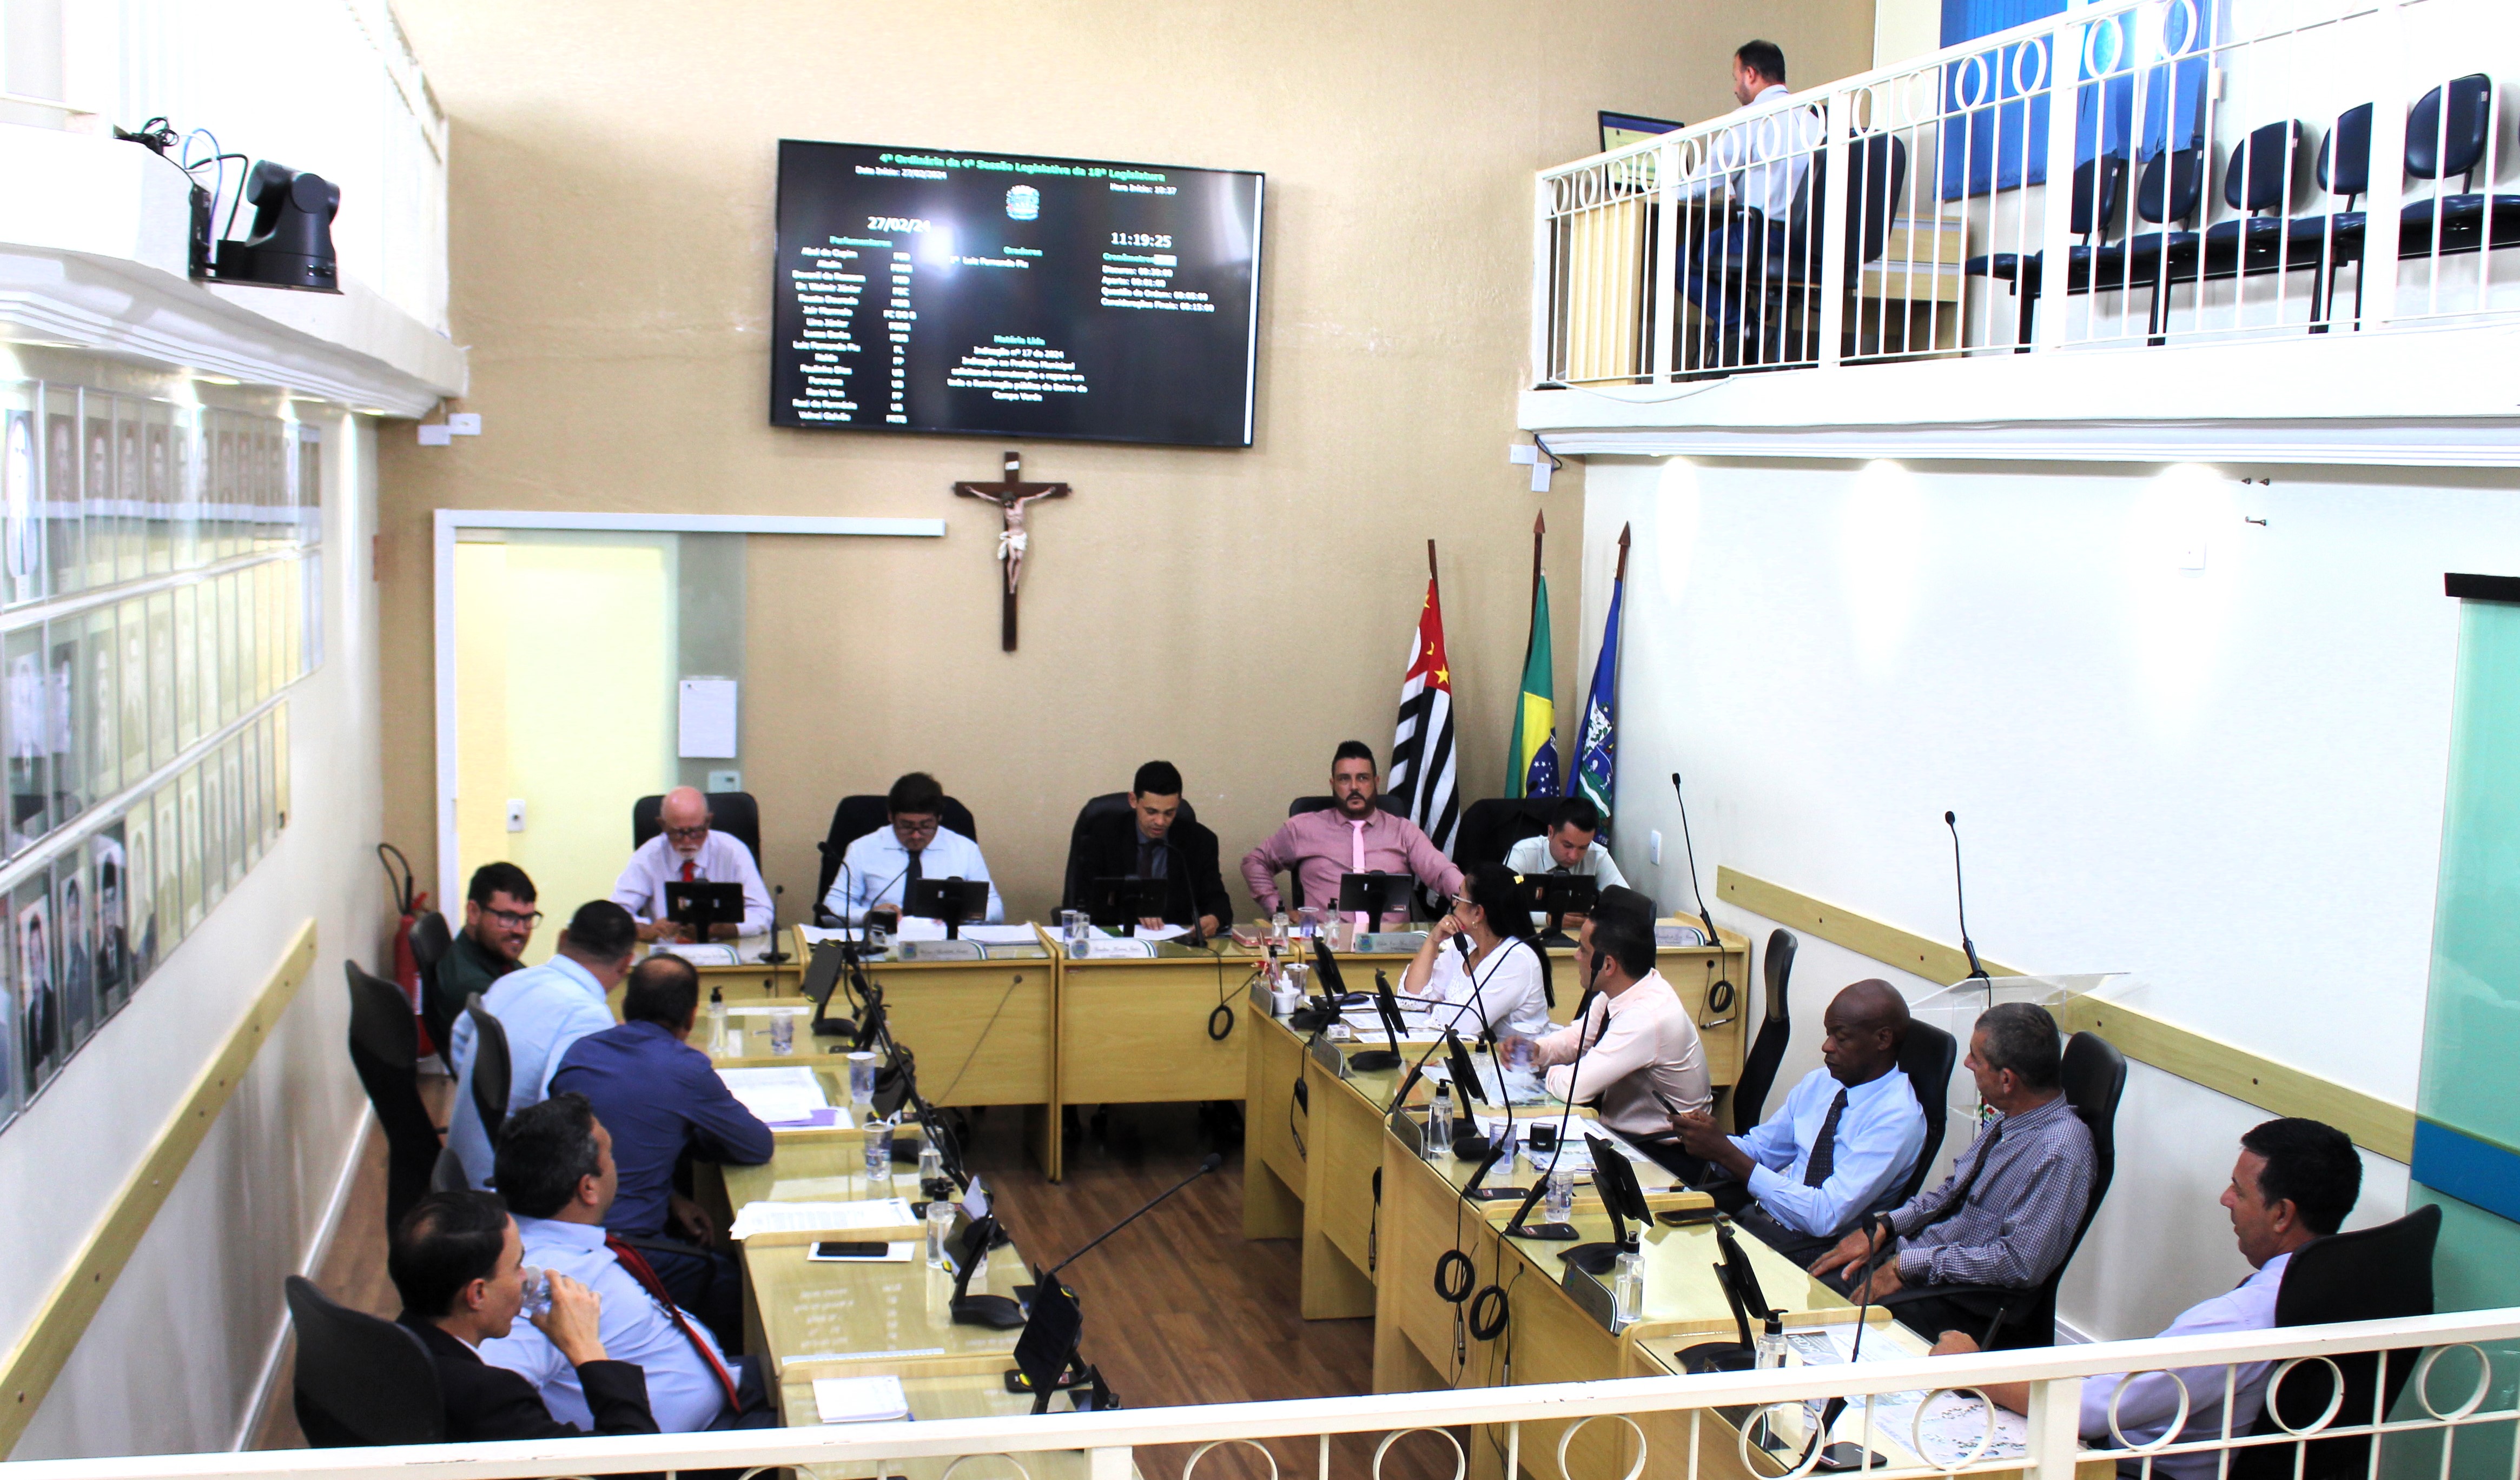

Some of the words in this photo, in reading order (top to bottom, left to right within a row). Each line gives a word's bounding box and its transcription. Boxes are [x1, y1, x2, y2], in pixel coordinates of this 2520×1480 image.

[856, 166, 875, 175] Data
[875, 167, 900, 176] Início:
[895, 155, 945, 167] Ordinária
[945, 158, 960, 168] da
[976, 160, 1014, 171] Sessão
[1015, 163, 1071, 175] Legislativa
[1072, 167, 1086, 176] da
[1109, 169, 1165, 182] Legislatura
[1110, 183, 1129, 192] Hora
[1129, 184, 1153, 194] Início:
[1154, 186, 1177, 195] 10:37
[868, 216, 931, 233] 27/02/24
[829, 235, 892, 248] Parlamentares
[1112, 233, 1172, 248] 11:19:25
[962, 256, 980, 266] Luiz
[979, 257, 1016, 267] Fernando
[1016, 260, 1028, 268] Piu
[1102, 276, 1129, 286] Aparte:
[1154, 301, 1178, 310] Finais:
[1180, 302, 1214, 312] 00:15:00
[793, 341, 810, 349] Luiz
[974, 347, 1010, 357] Indicação
[962, 357, 998, 367] Indicação
[1040, 361, 1075, 371] Municipal
[993, 391, 1020, 401] Campo
[1020, 393, 1042, 401] Verde
